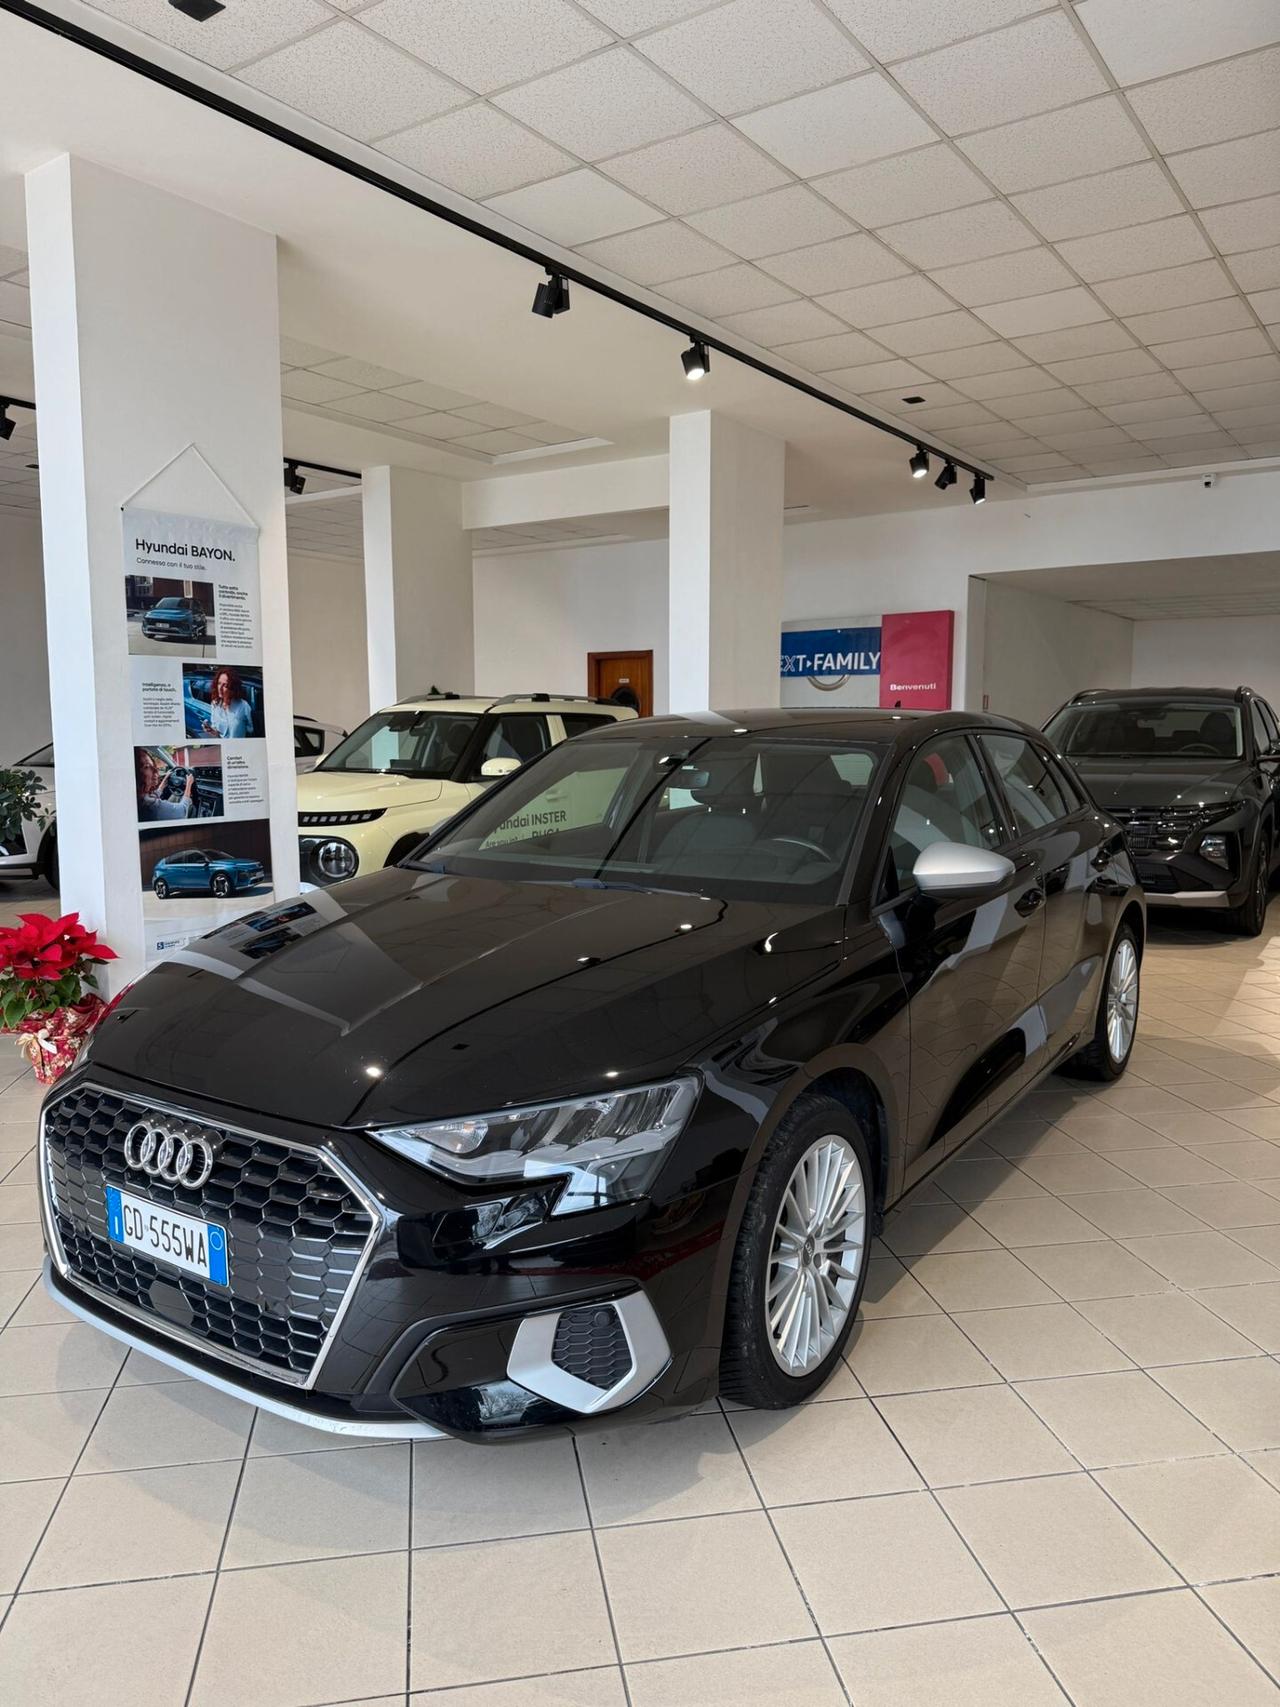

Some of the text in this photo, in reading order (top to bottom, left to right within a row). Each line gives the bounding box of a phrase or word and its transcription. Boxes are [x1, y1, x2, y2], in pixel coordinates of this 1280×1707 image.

[136, 538, 236, 562] Hyundai BAYON.
[136, 557, 166, 567] Connesso
[813, 652, 881, 671] FAMILY
[890, 682, 937, 691] Benvenuti
[494, 814, 530, 834] undai
[531, 810, 567, 826] INSTER
[123, 1204, 208, 1268] GD 555WA
